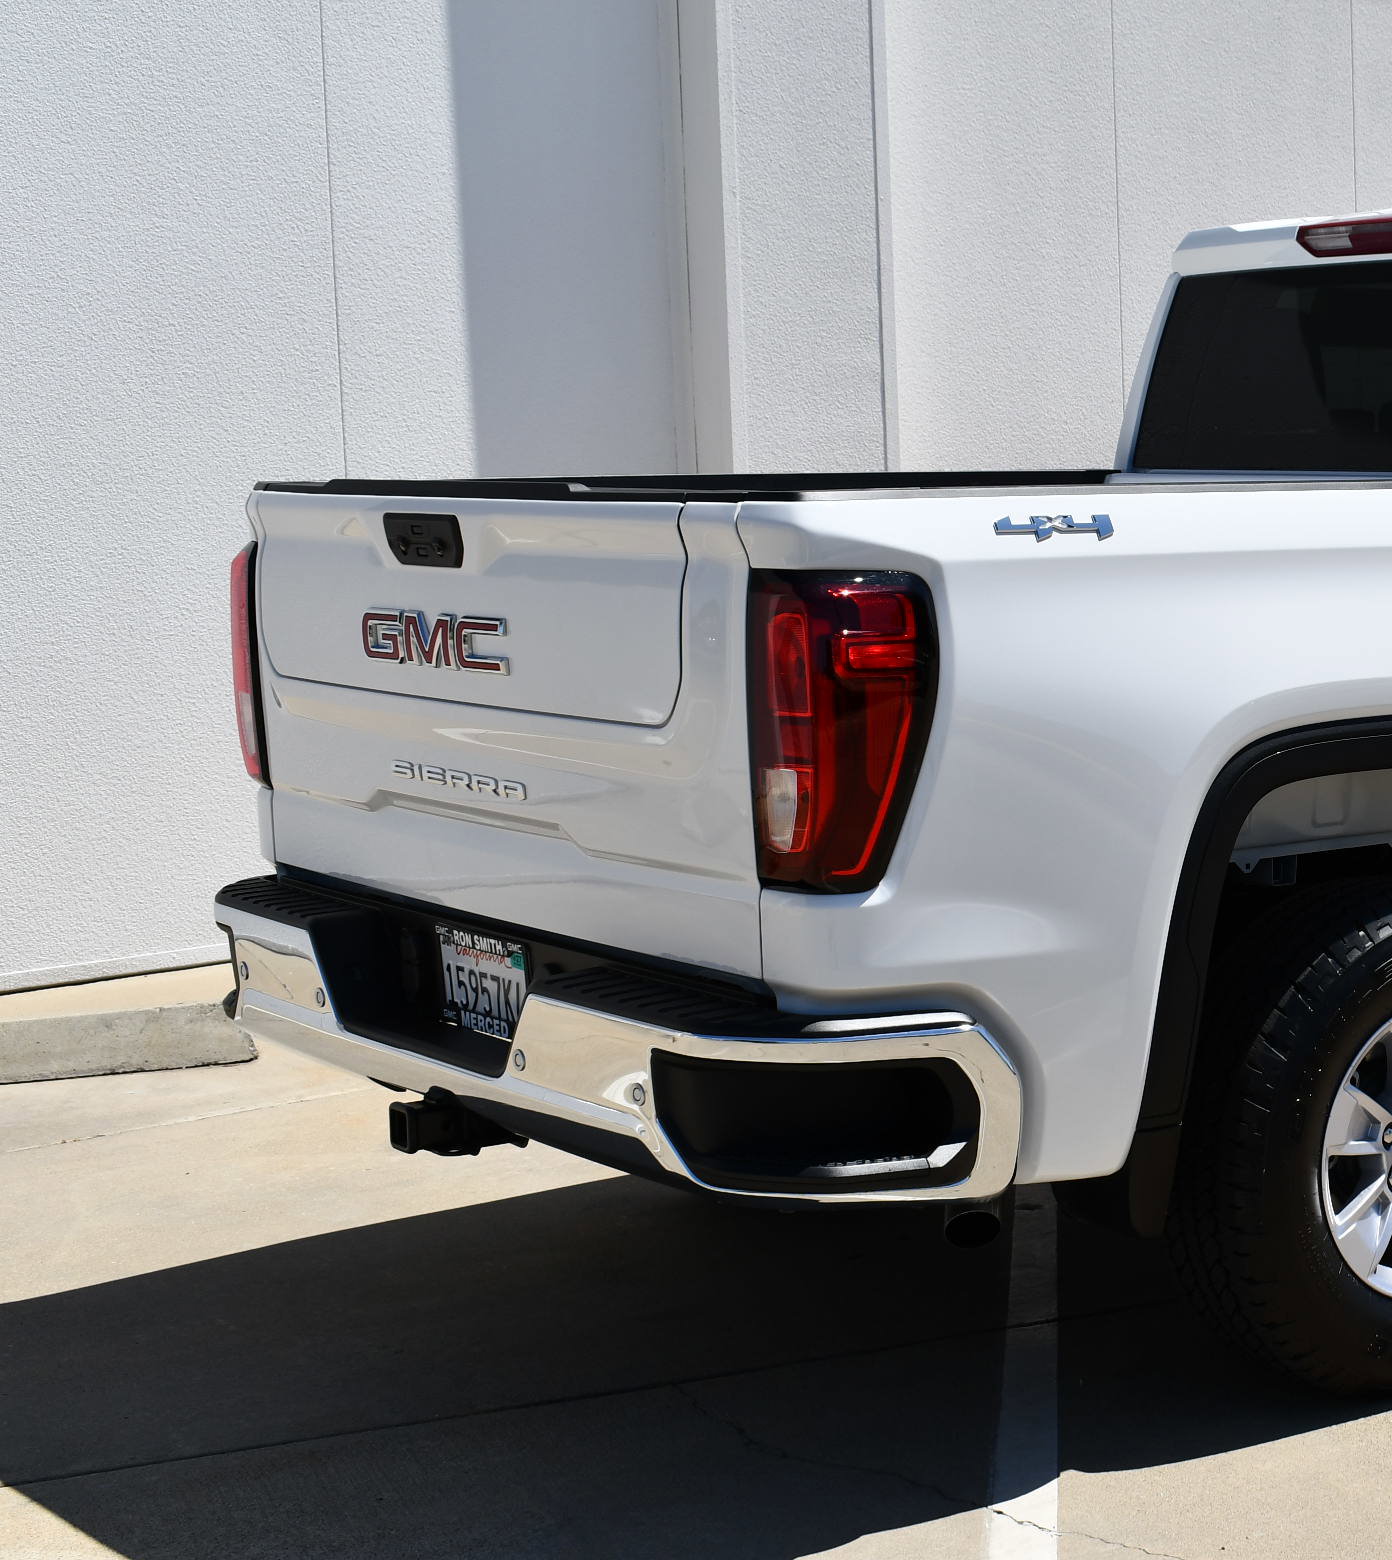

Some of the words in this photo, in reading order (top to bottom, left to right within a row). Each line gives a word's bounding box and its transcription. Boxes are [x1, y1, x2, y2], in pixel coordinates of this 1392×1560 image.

[361, 606, 510, 676] GMC
[391, 758, 527, 800] SIERRA
[453, 929, 472, 948] RON
[474, 934, 503, 955] SMITH
[507, 942, 522, 953] GMC
[461, 1010, 509, 1038] MERCED
